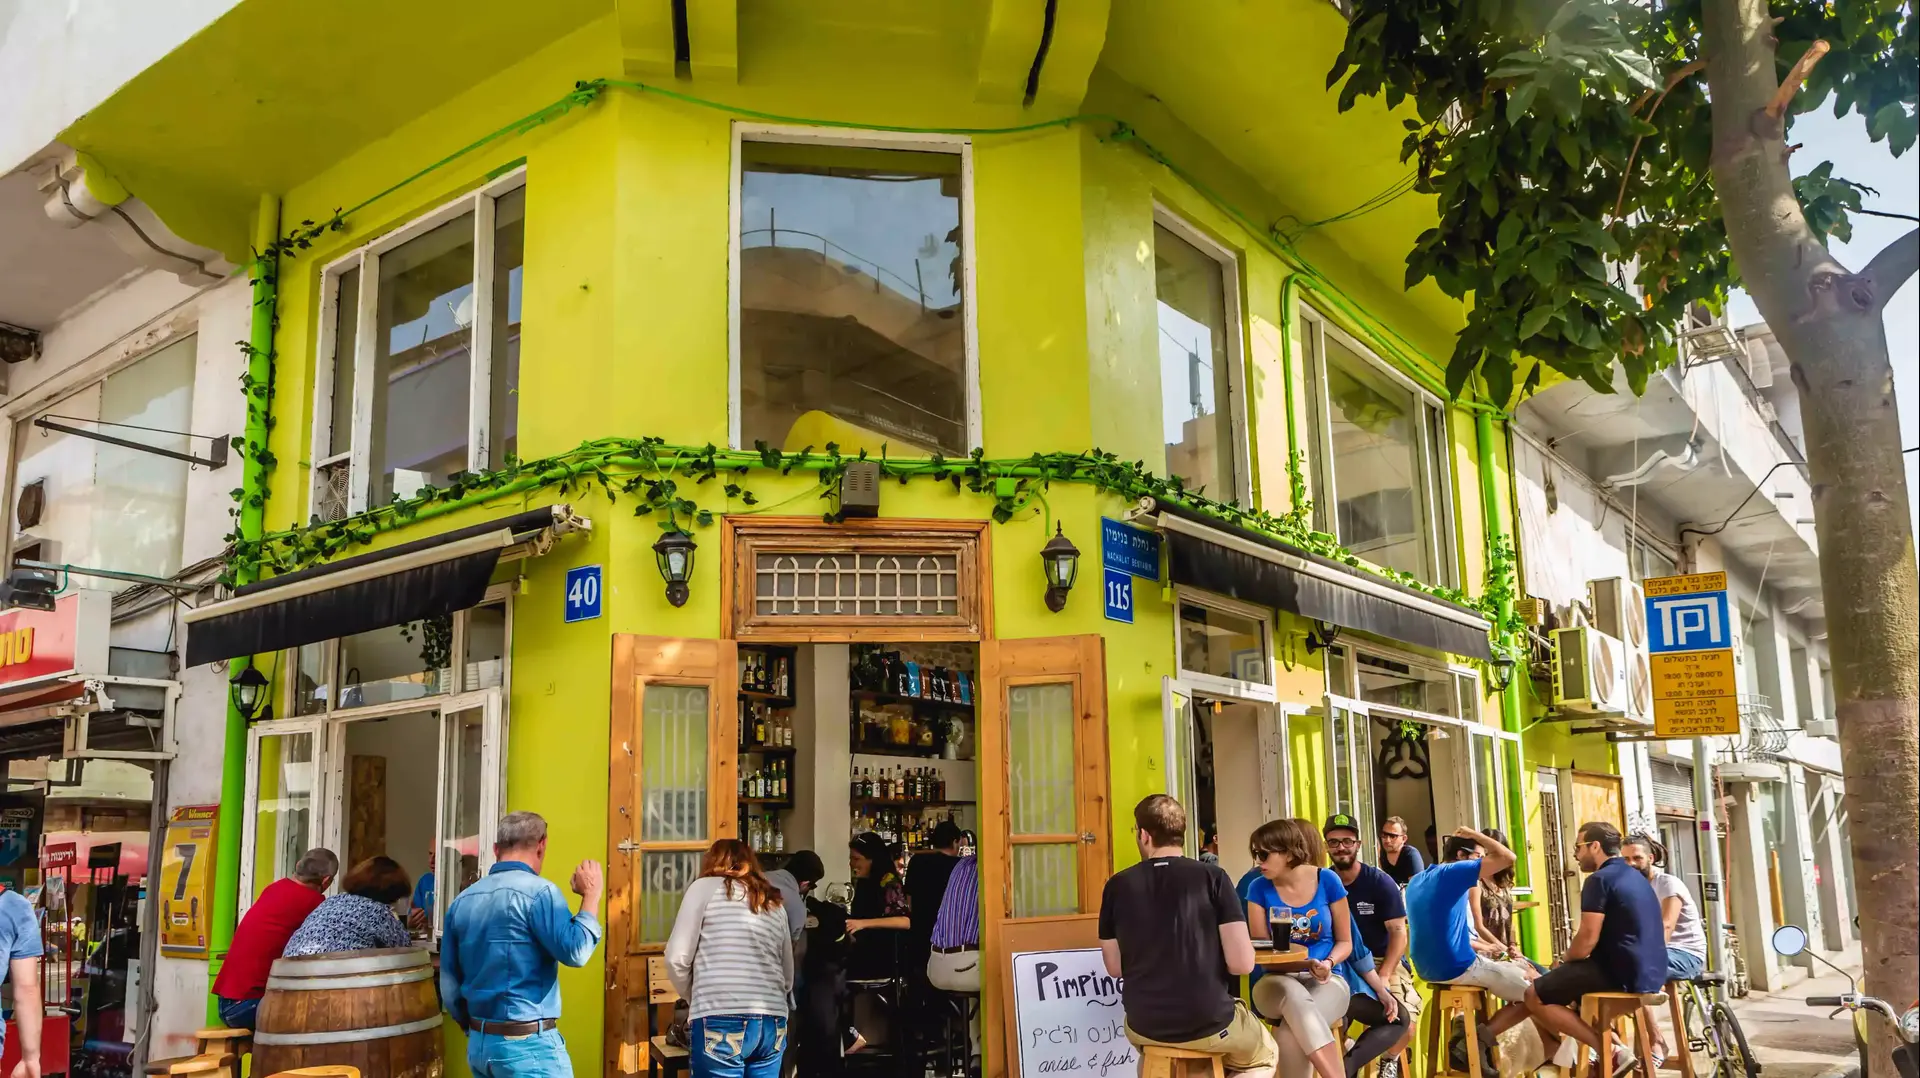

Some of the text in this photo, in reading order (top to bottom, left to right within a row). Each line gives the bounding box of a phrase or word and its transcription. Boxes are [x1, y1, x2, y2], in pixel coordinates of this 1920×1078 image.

[1105, 527, 1149, 551] נחלת בנימין
[568, 576, 597, 608] 40
[1704, 581, 1722, 589] לרכב
[1108, 581, 1130, 611] 115
[1664, 653, 1720, 663] חניה בתשלום
[1698, 707, 1717, 715] לרכב
[188, 808, 214, 819] Winner
[1038, 1047, 1135, 1077] anise & fish
